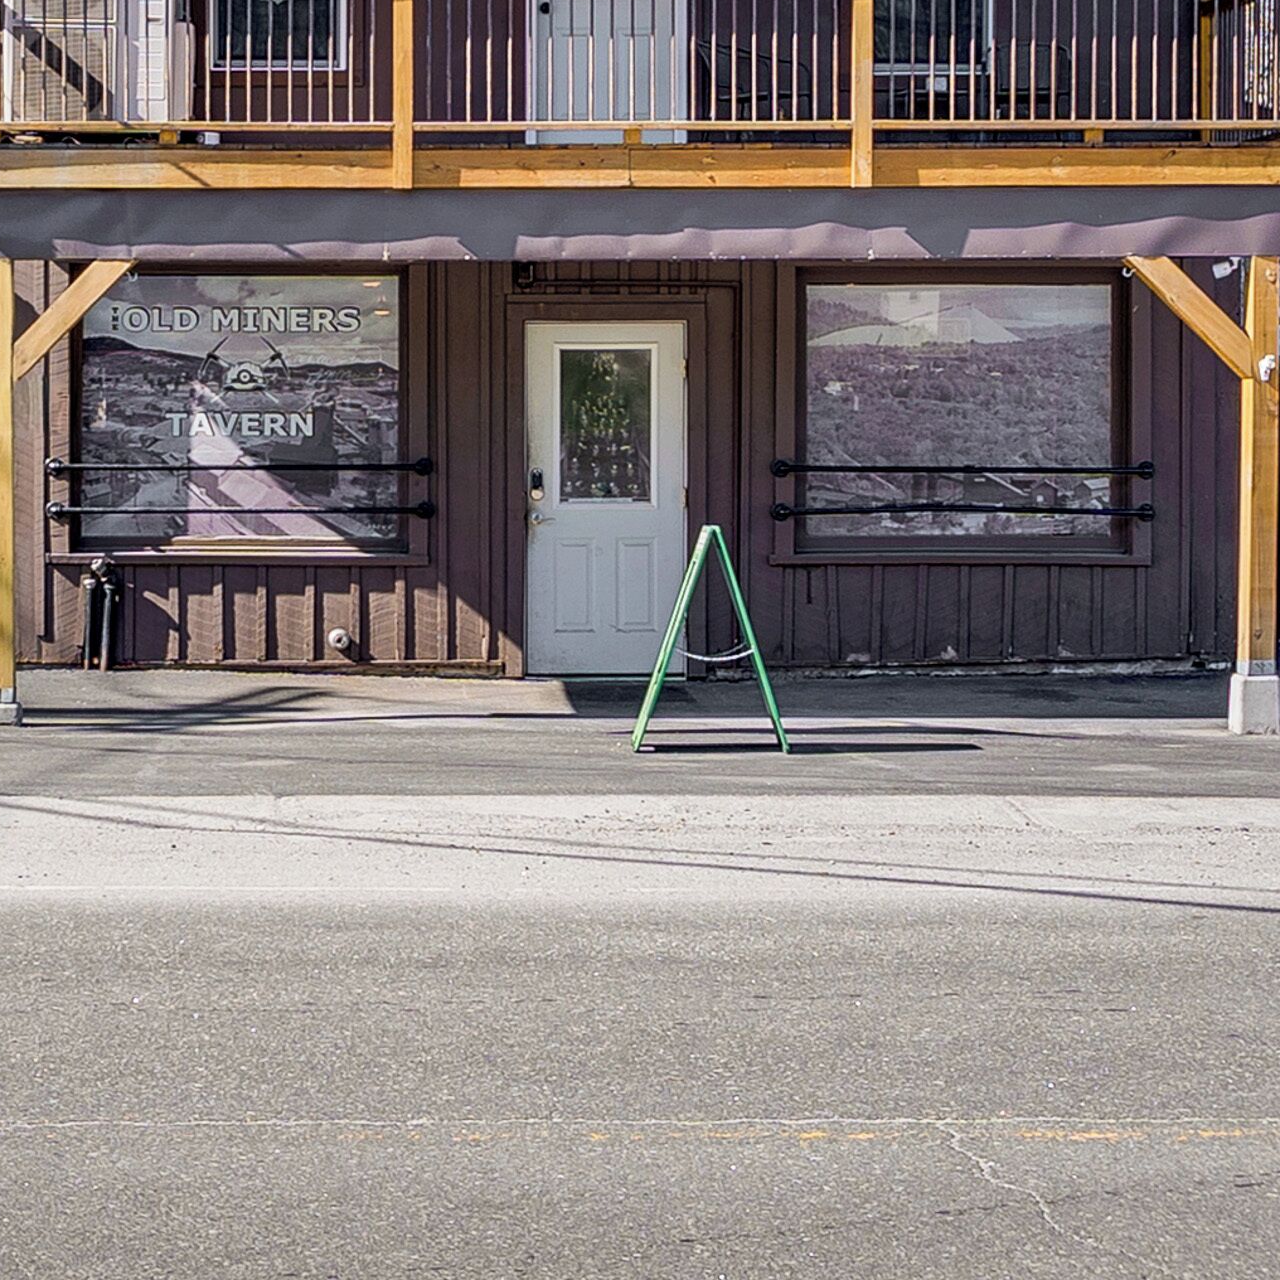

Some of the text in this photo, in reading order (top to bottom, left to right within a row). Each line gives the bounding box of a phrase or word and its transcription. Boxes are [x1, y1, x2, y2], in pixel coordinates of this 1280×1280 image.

[111, 305, 361, 333] THE OLD MINERS
[164, 409, 315, 438] TAVERN
